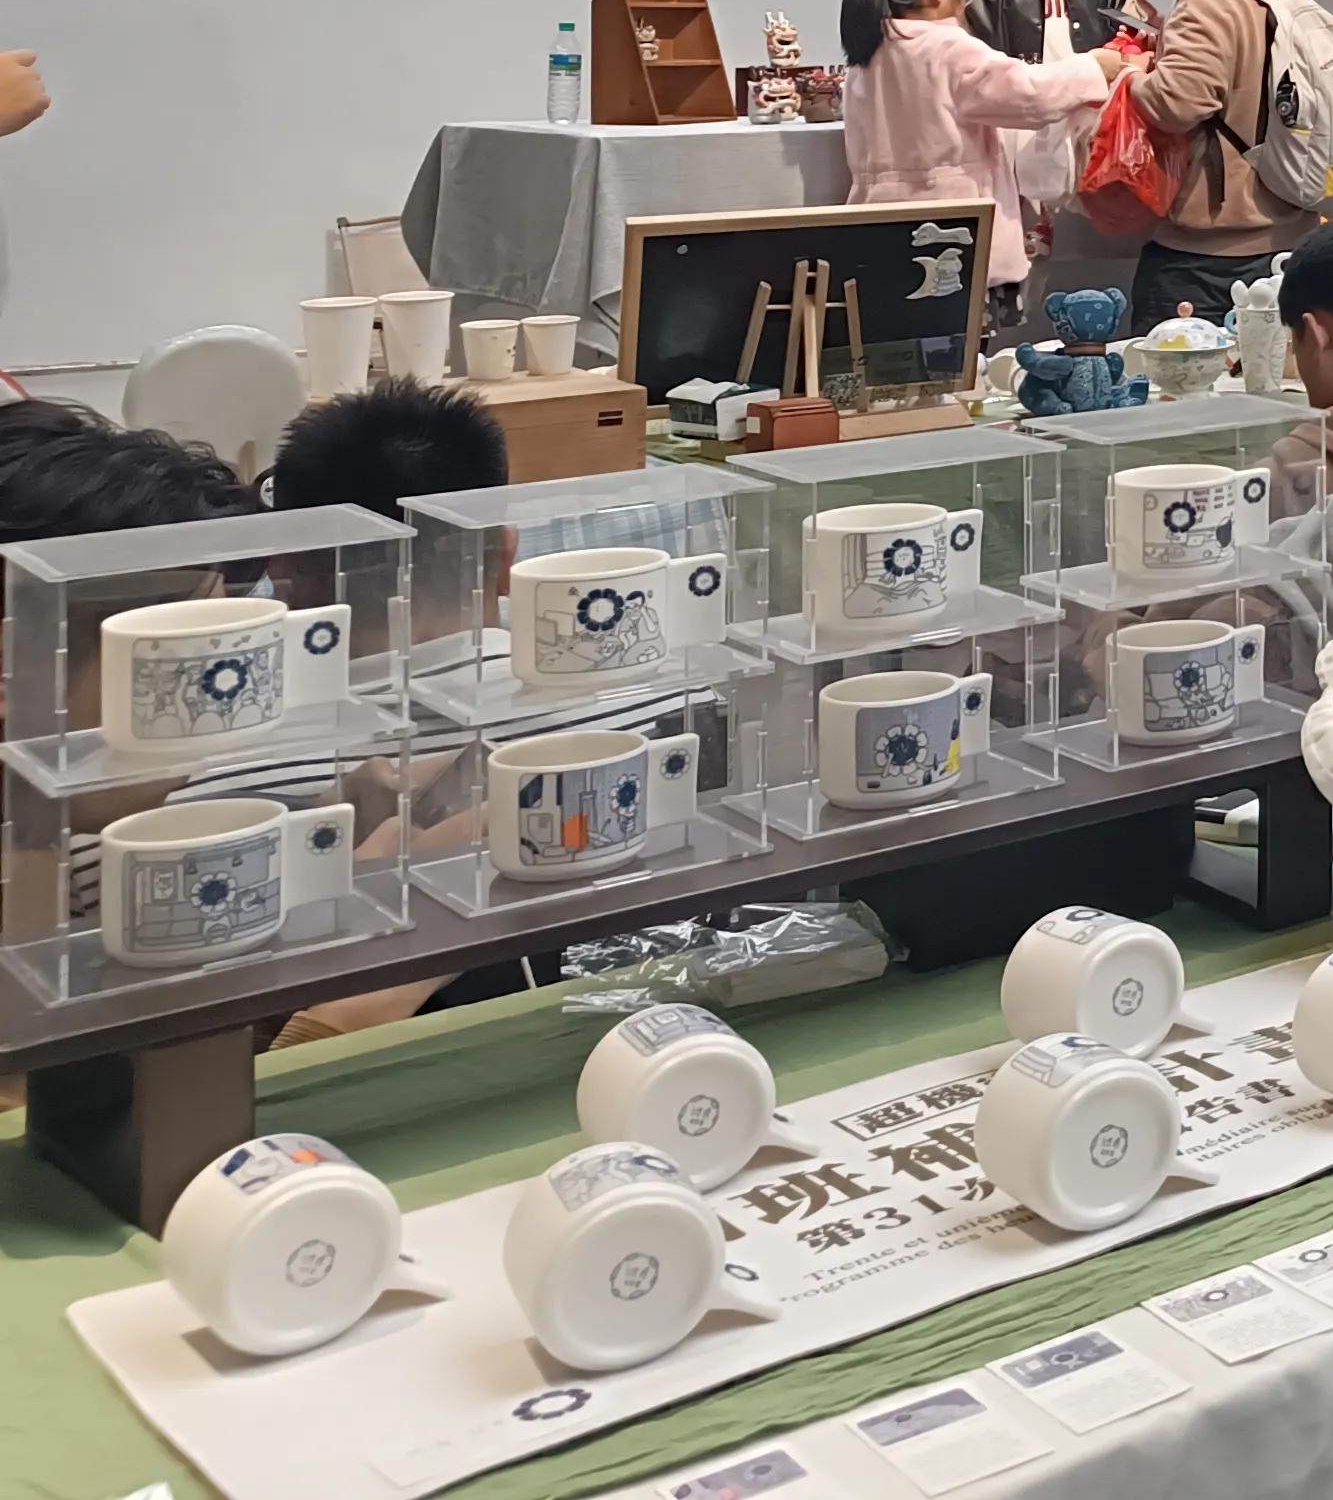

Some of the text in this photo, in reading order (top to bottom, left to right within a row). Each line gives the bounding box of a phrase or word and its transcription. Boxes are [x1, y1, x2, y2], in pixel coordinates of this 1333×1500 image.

[854, 1072, 996, 1134] 超機
[803, 1248, 896, 1281] Trente
[1185, 1115, 1281, 1155] médiaire
